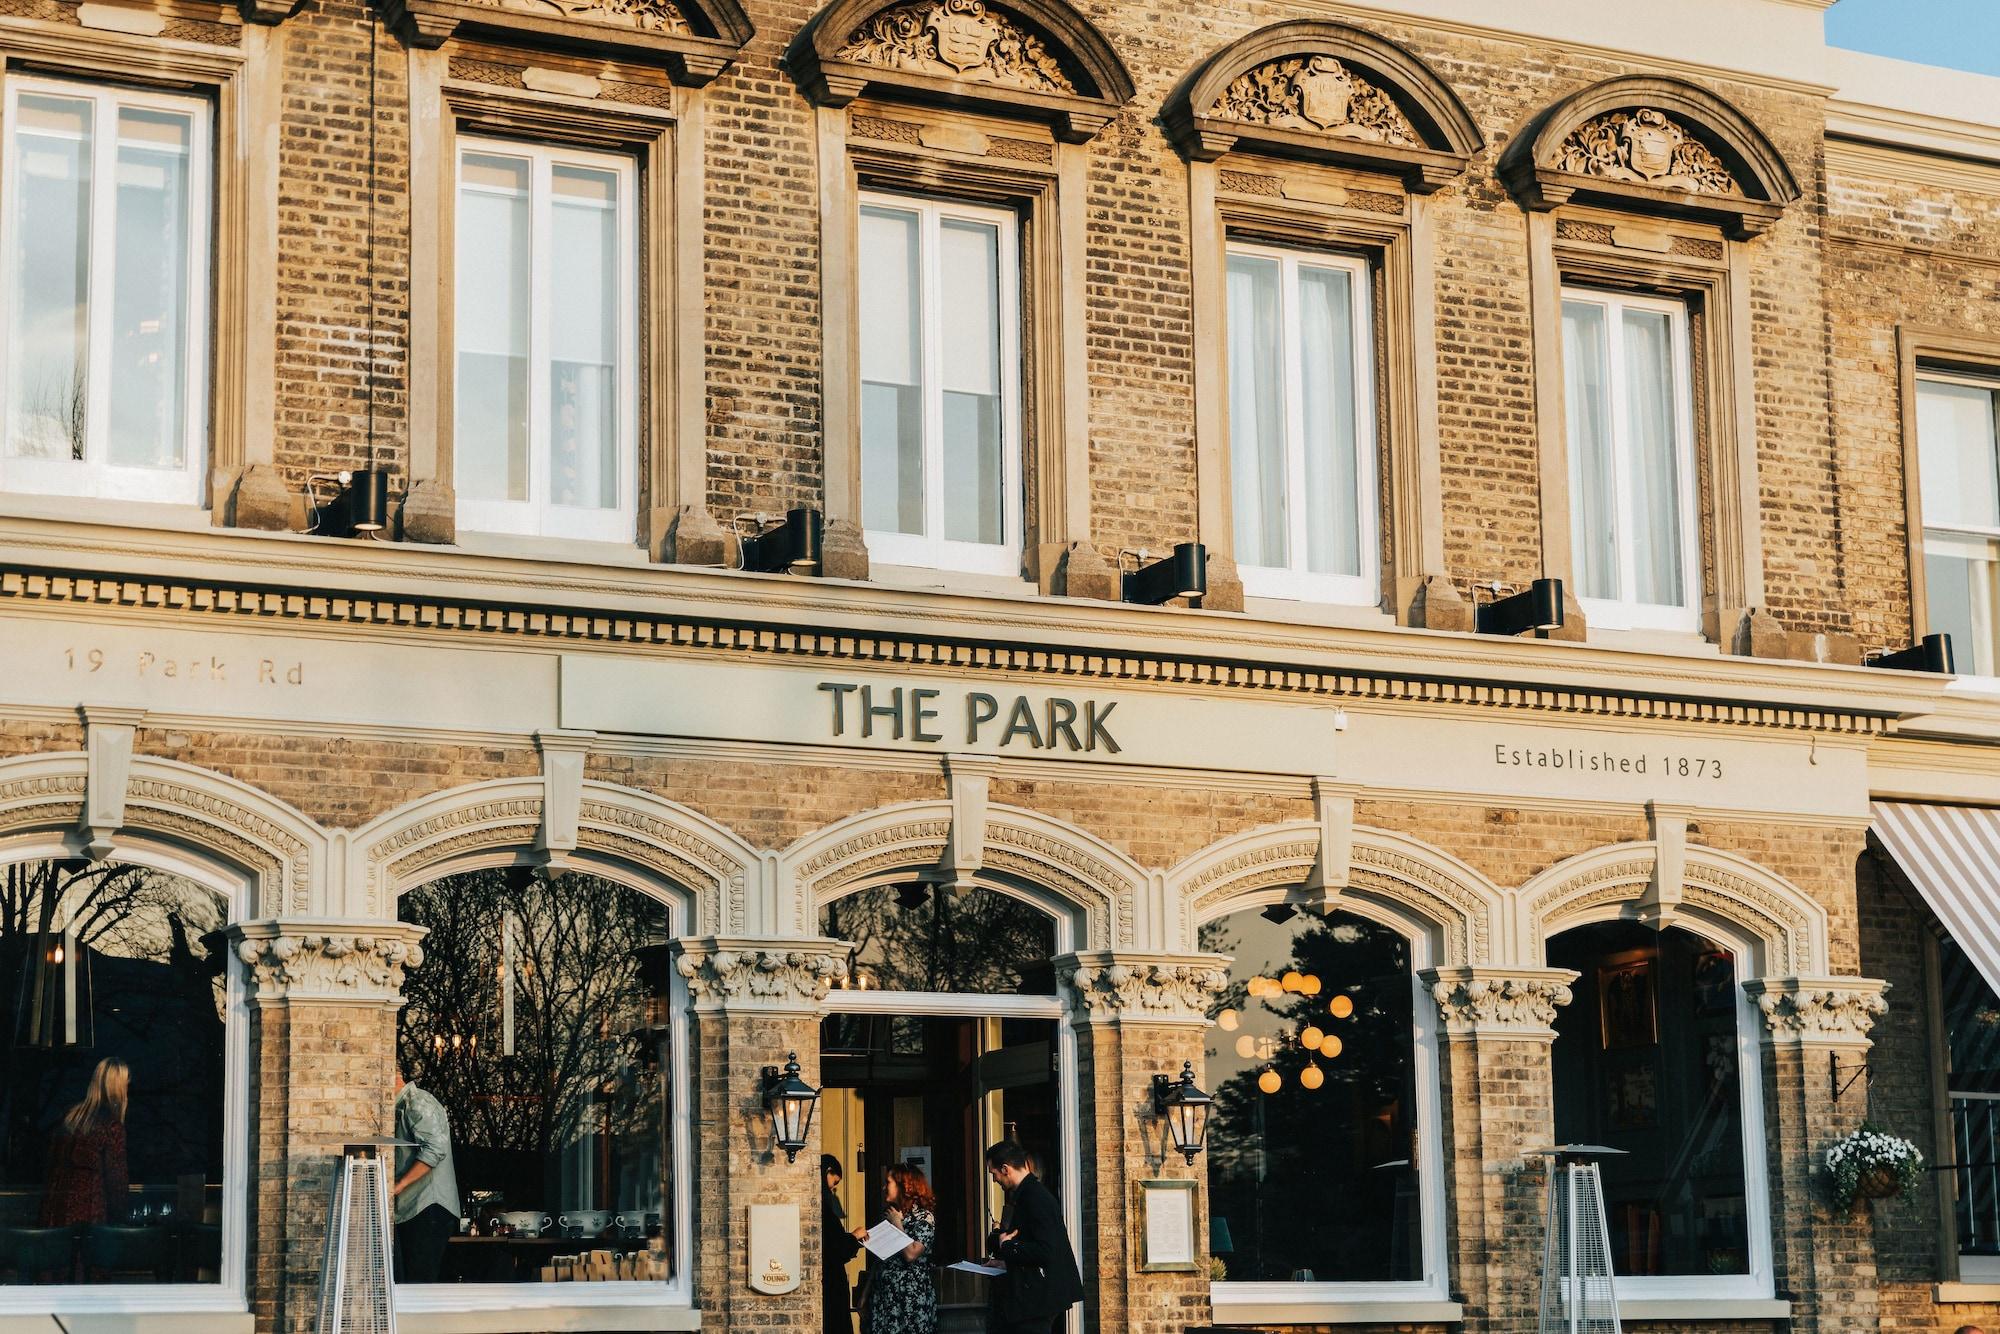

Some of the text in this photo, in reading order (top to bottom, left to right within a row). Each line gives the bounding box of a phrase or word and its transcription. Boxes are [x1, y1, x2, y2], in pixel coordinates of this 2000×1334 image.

[64, 647, 303, 685] 19 Park Rd
[817, 682, 1122, 754] THE PARK
[1494, 744, 1723, 779] Established 1873
